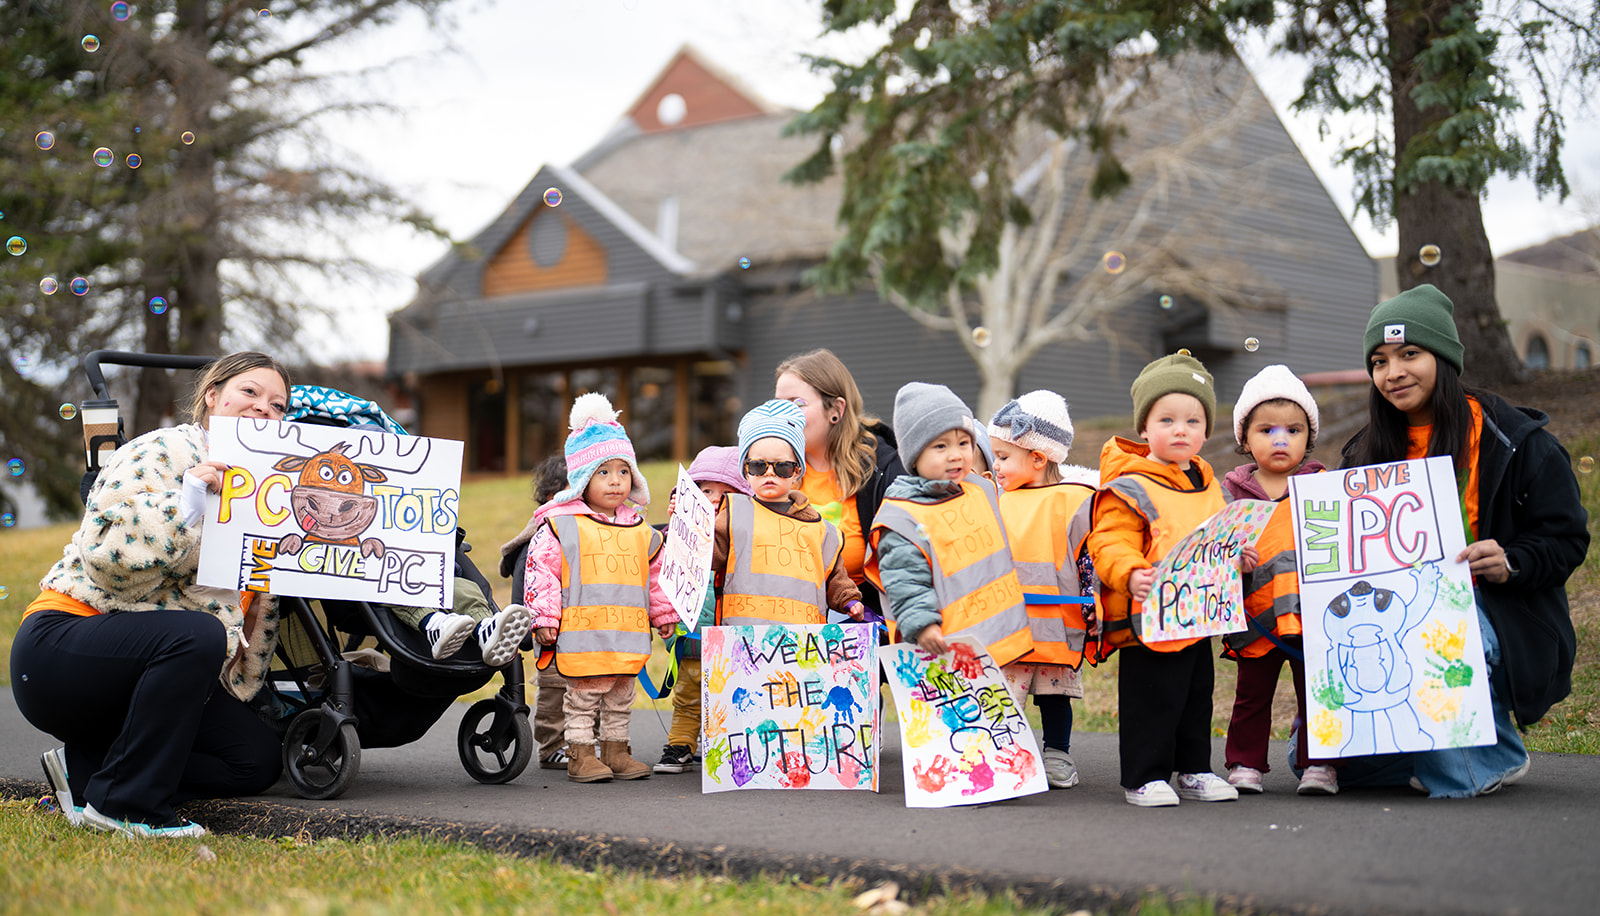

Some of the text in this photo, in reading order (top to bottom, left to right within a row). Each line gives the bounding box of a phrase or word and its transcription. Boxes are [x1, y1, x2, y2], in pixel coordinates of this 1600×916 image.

[1343, 463, 1410, 497] GIVE
[217, 466, 458, 535] PC TOTS
[678, 479, 710, 537] PC TOTS
[941, 503, 975, 532] PC
[597, 527, 629, 552] PC
[778, 517, 810, 549] PC
[944, 525, 994, 560] TOTS
[1304, 500, 1341, 576] LIVE
[1349, 491, 1428, 573] PC
[245, 538, 278, 593] LIVE
[298, 543, 426, 594] GIVE PC
[582, 553, 640, 576] TOTS
[752, 545, 814, 572] TOTS
[1159, 580, 1195, 631] PC
[742, 633, 858, 665] WE ARE
[762, 680, 823, 710] THE
